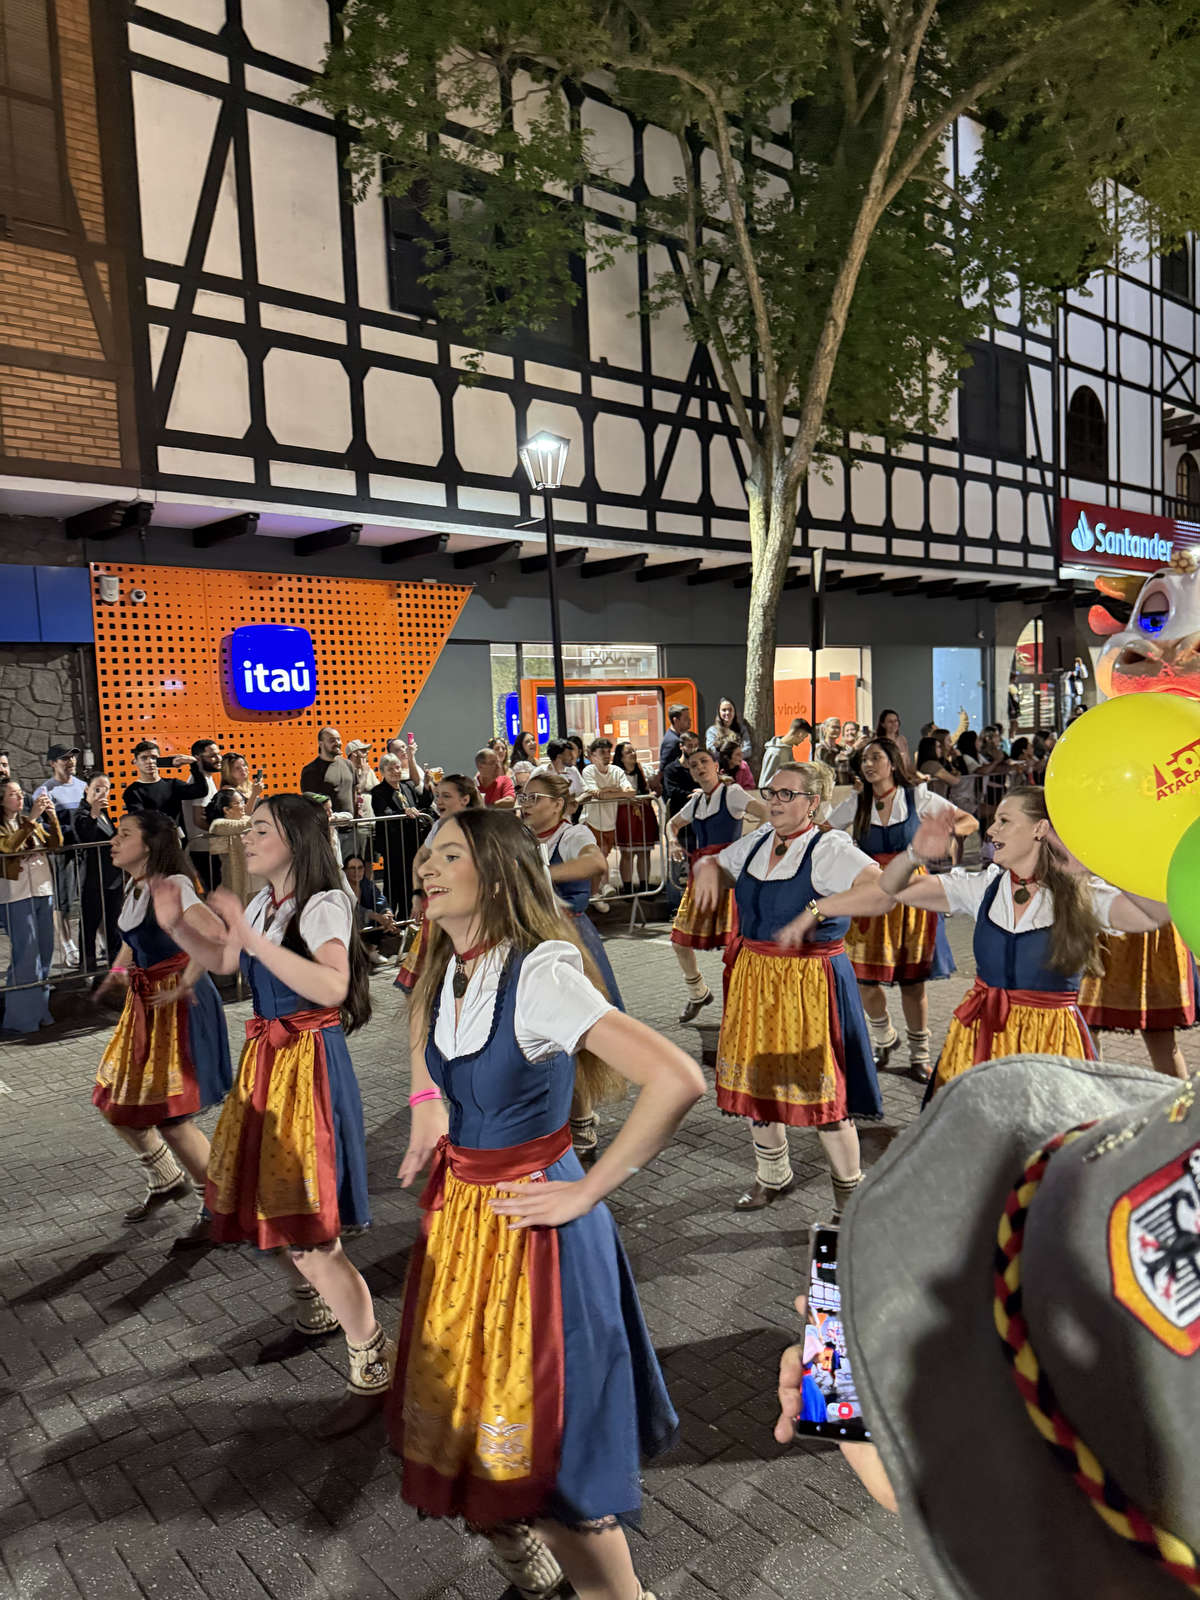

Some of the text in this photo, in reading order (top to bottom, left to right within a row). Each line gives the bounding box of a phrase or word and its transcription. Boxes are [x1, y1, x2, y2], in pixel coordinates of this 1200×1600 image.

[1095, 523, 1173, 562] Santander
[243, 660, 310, 693] itaú
[512, 713, 547, 735] iú
